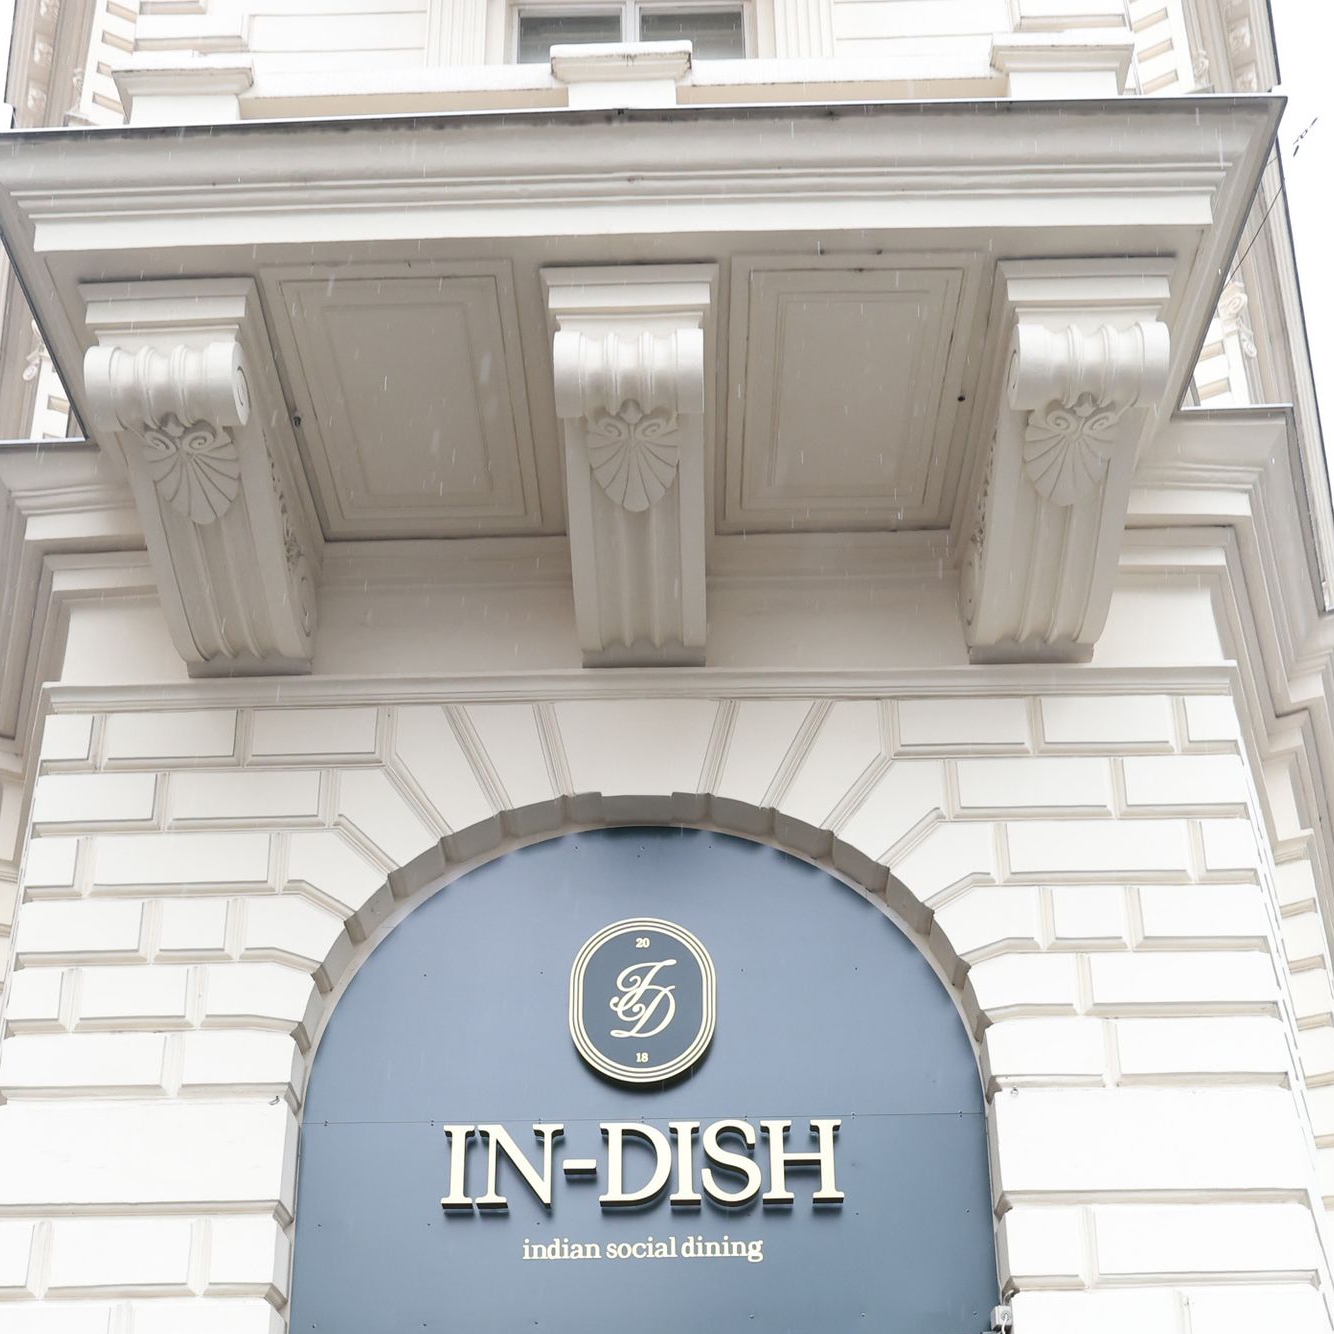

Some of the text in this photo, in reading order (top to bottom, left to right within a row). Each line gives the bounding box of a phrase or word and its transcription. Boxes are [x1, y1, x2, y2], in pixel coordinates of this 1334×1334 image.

[635, 938, 651, 948] 20
[635, 1052, 649, 1063] 18
[440, 1119, 845, 1209] IN-DISH
[522, 1235, 764, 1263] indian social dining
